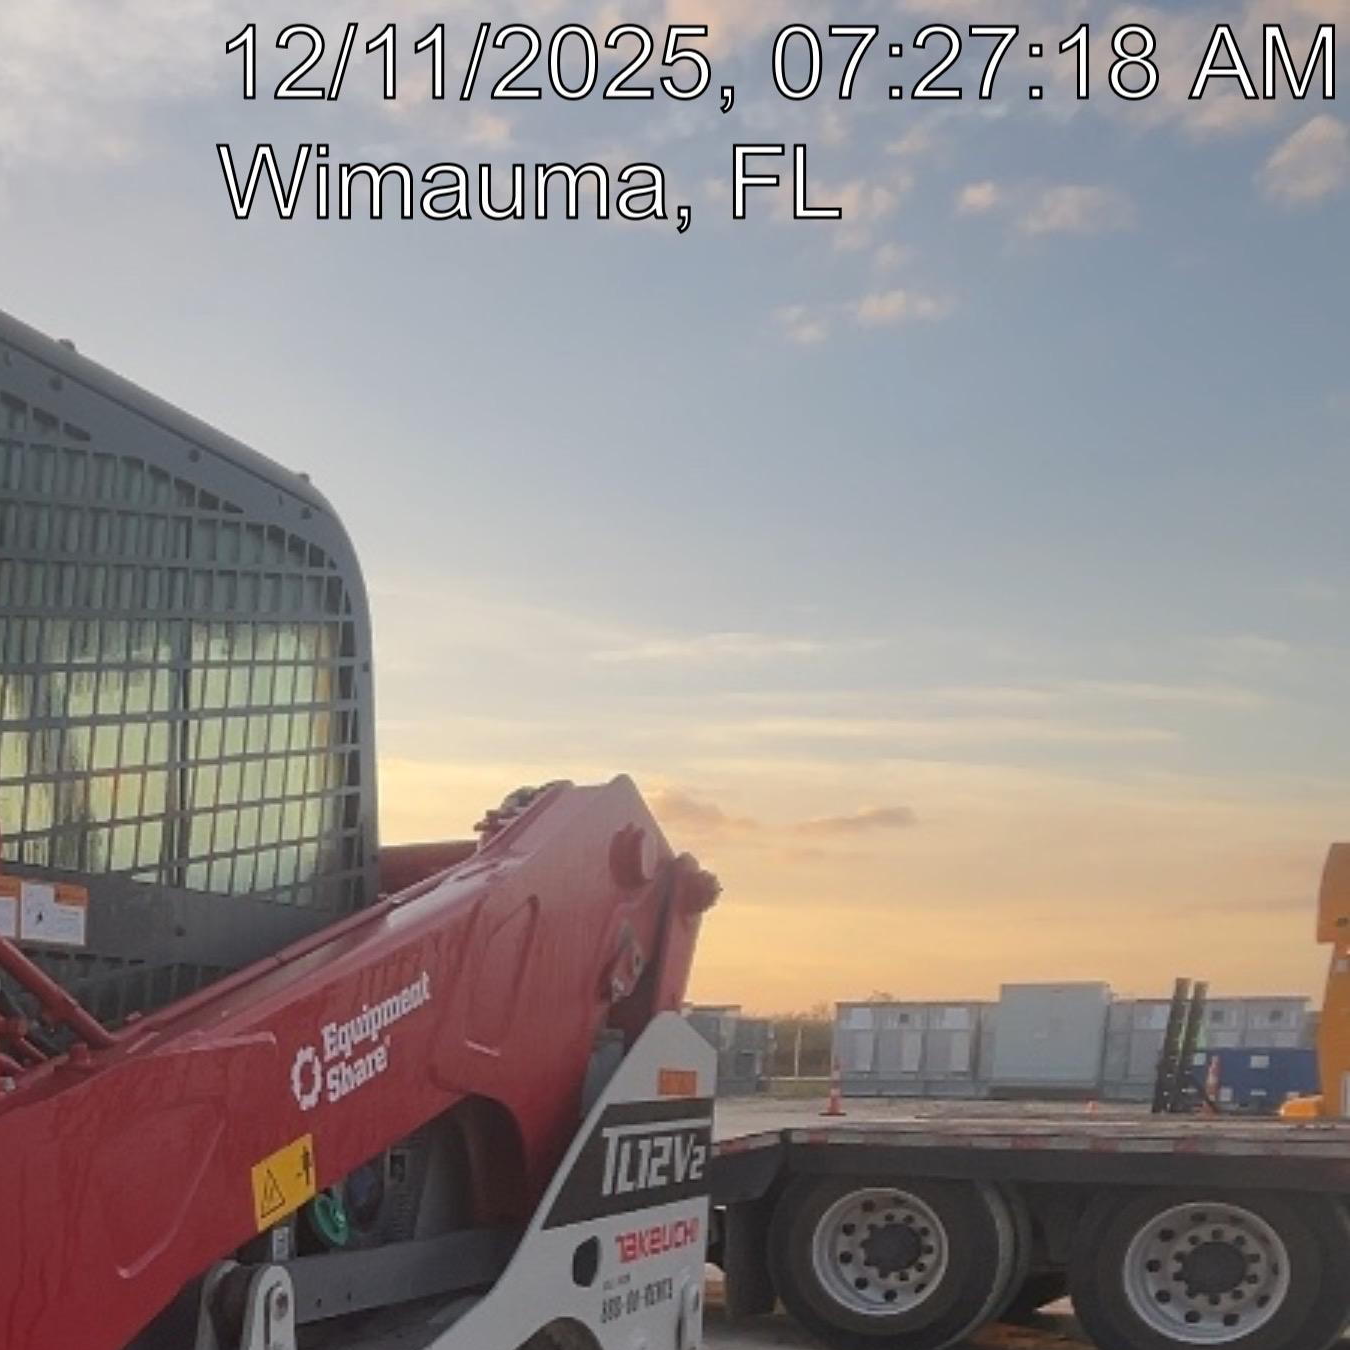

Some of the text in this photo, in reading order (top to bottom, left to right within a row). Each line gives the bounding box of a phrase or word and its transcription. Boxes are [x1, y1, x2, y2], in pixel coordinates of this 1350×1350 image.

[321, 971, 431, 1062] Equipment
[326, 1044, 388, 1103] Share
[601, 1118, 711, 1197] TL12V2
